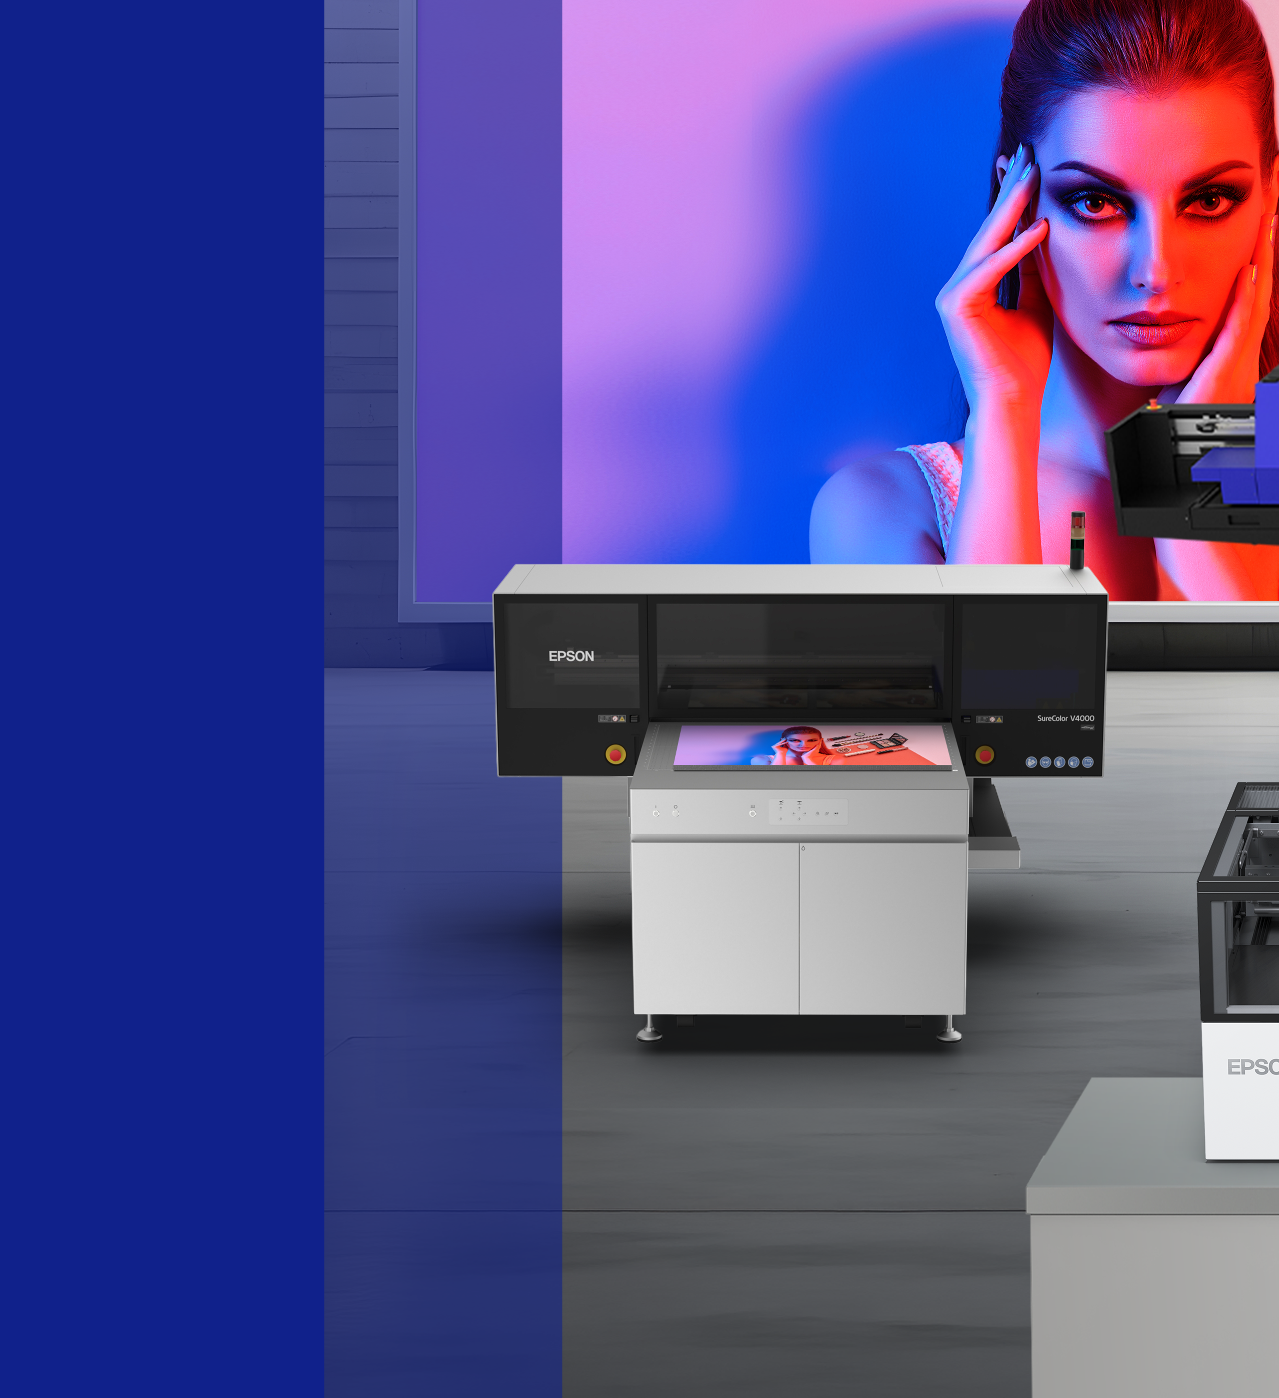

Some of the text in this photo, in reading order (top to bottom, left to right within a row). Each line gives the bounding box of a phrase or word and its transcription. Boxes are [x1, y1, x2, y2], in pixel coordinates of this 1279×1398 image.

[548, 650, 595, 662] EPSON
[1037, 714, 1095, 722] SureColor V4000
